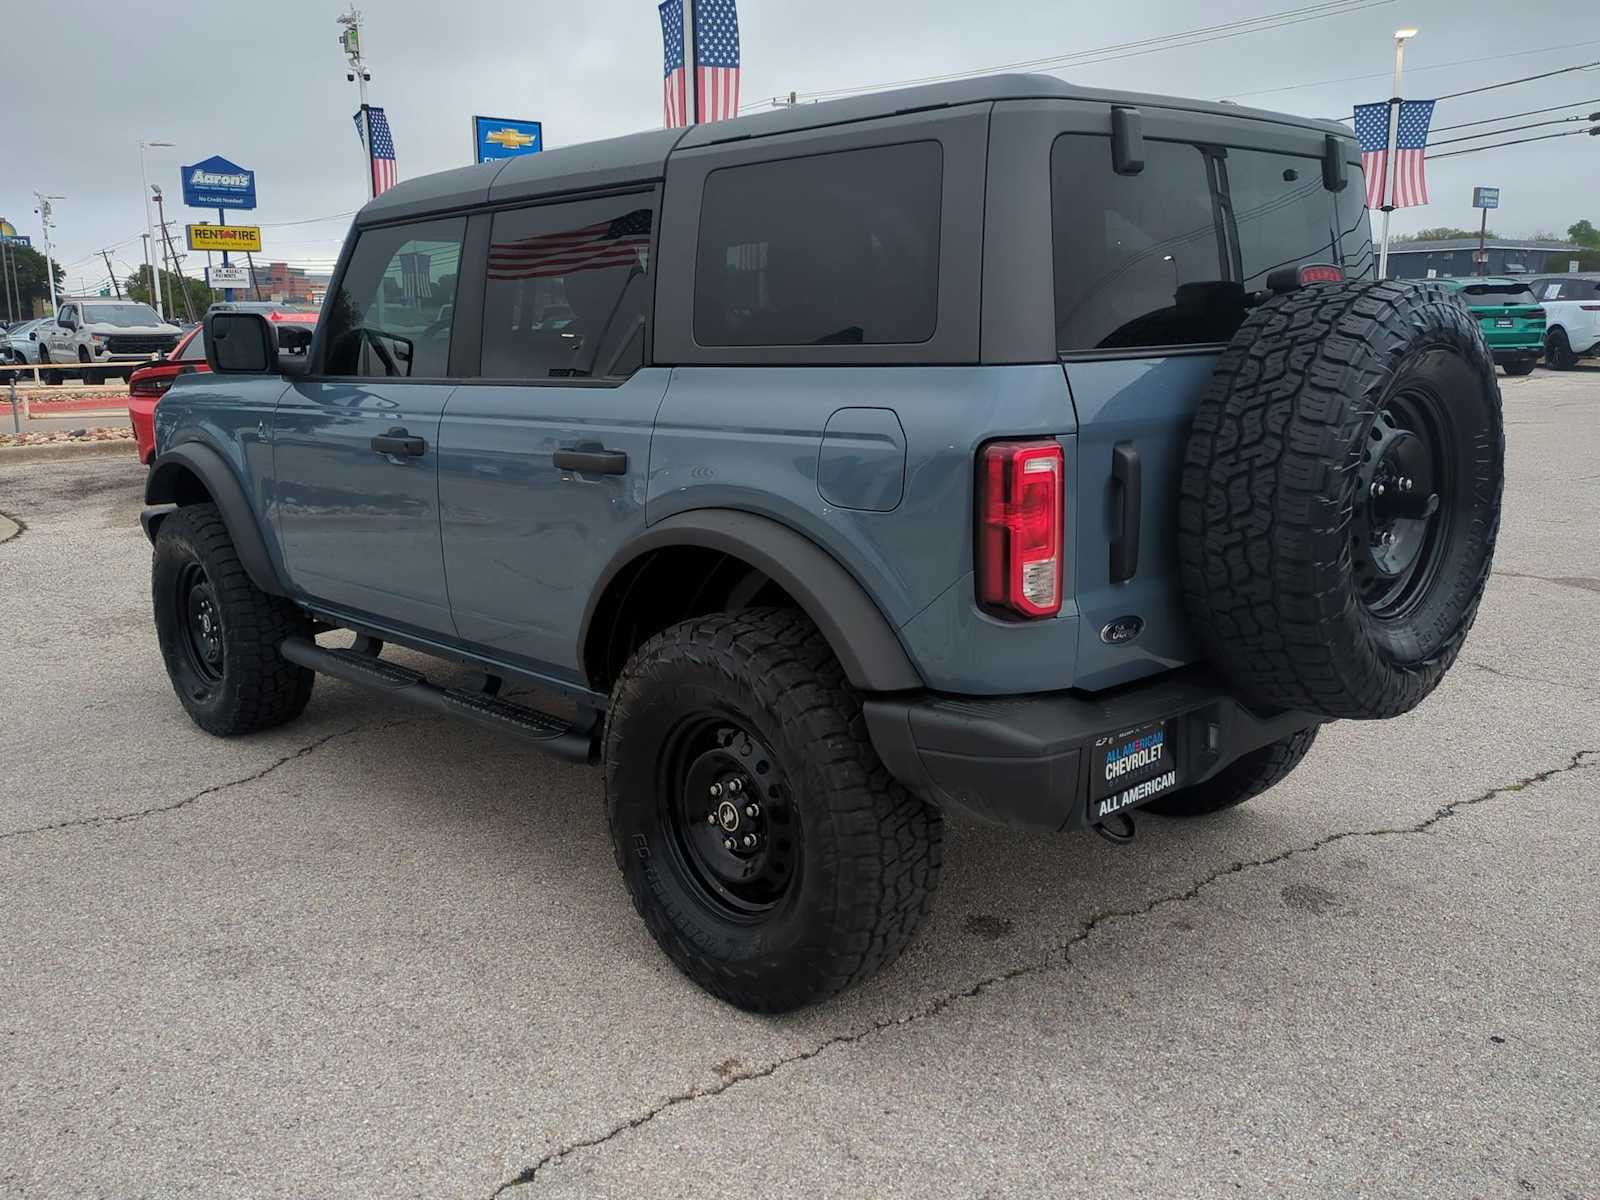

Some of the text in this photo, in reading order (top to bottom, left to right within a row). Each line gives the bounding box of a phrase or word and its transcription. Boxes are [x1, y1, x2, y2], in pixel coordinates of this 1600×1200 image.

[192, 170, 248, 187] Aaron's
[195, 229, 256, 240] RENT TIRE
[1105, 743, 1163, 780] CHEVROLET
[1106, 749, 1121, 762] ALL
[1122, 731, 1164, 757] AMERICAN
[1099, 795, 1121, 817] ALL
[1121, 770, 1176, 808] AMERICAN
